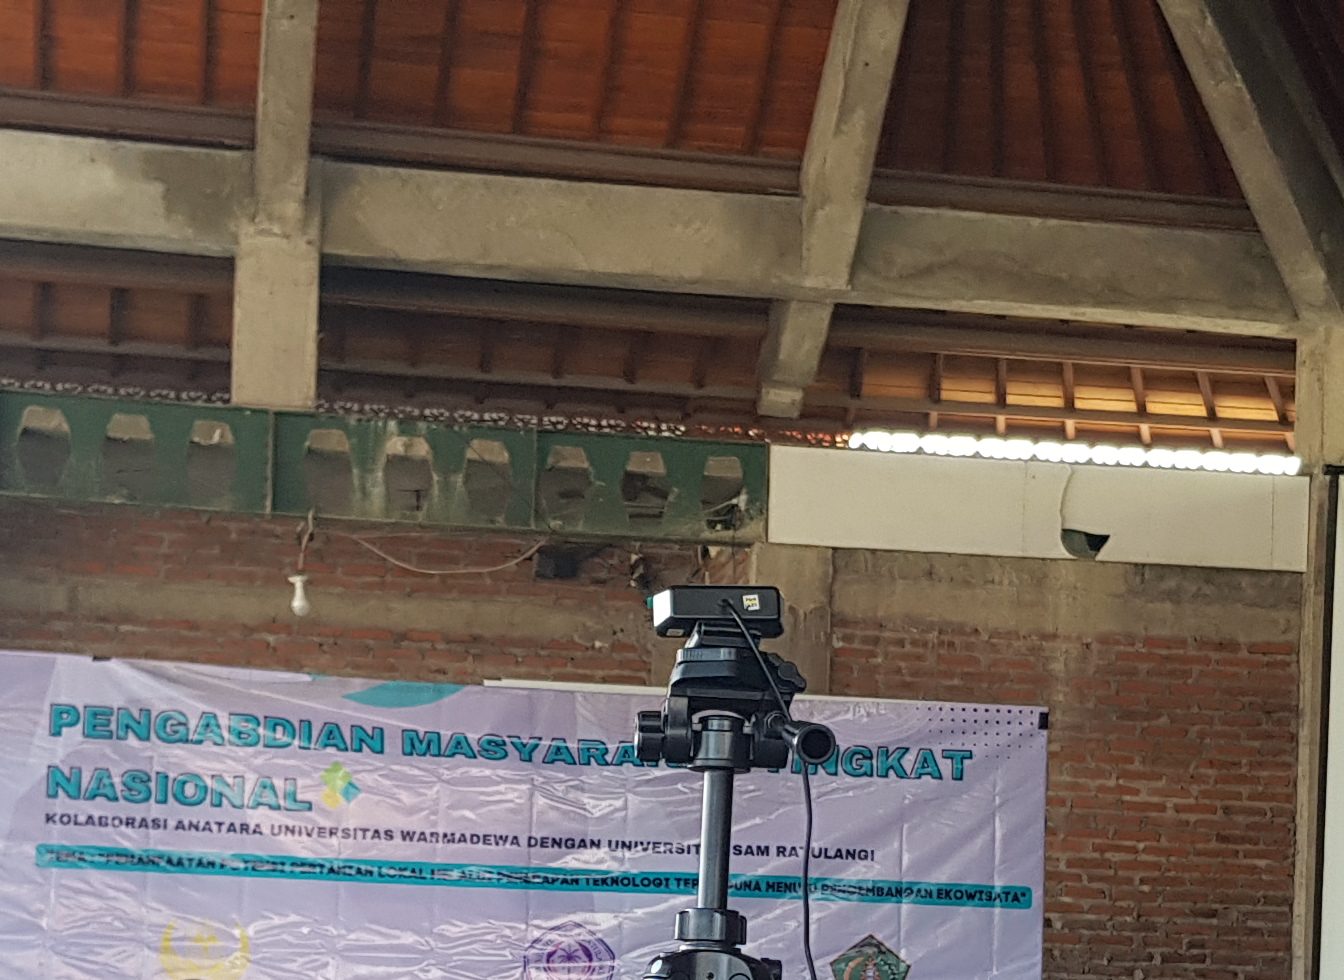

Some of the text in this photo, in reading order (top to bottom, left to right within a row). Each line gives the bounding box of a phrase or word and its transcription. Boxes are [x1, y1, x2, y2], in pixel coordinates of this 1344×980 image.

[48, 703, 973, 781] PENGABDIAN MASYARA INGKAT
[46, 765, 313, 811] NASIONAL
[45, 813, 875, 861] KOLABORASI ANATARA UNIVERSITAS WARMADEWA DENGAN UNIVERSIT SAM RAULANGI
[675, 877, 699, 889] TEP
